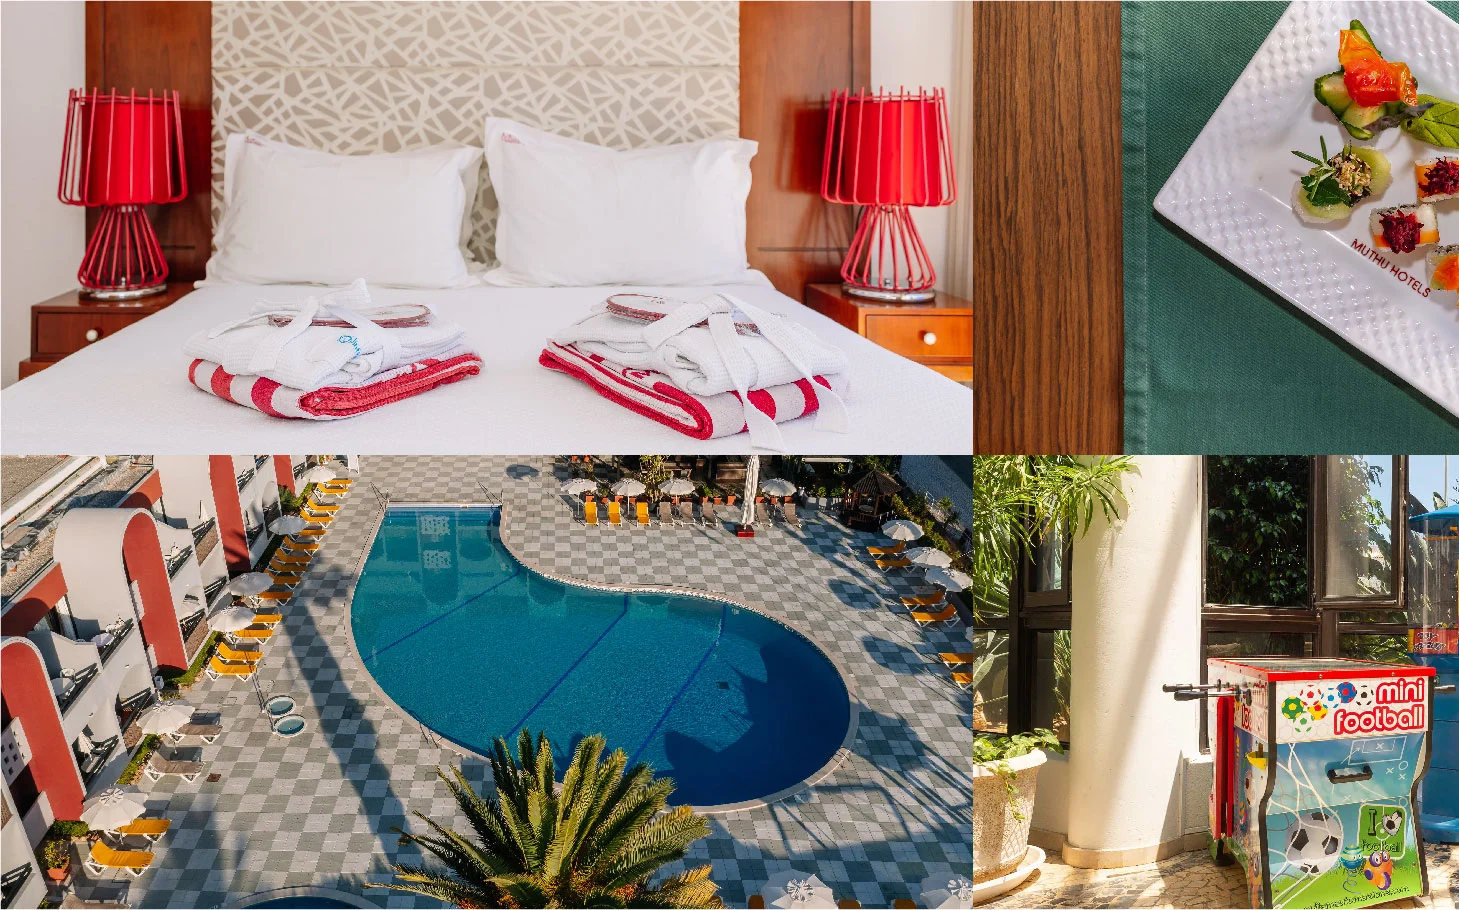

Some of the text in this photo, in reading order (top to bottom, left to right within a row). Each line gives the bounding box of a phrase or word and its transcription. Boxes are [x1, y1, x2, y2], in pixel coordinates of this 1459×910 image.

[1350, 238, 1431, 298] MUTHU HOTELS
[1375, 677, 1425, 704] mini
[1333, 704, 1425, 735] football
